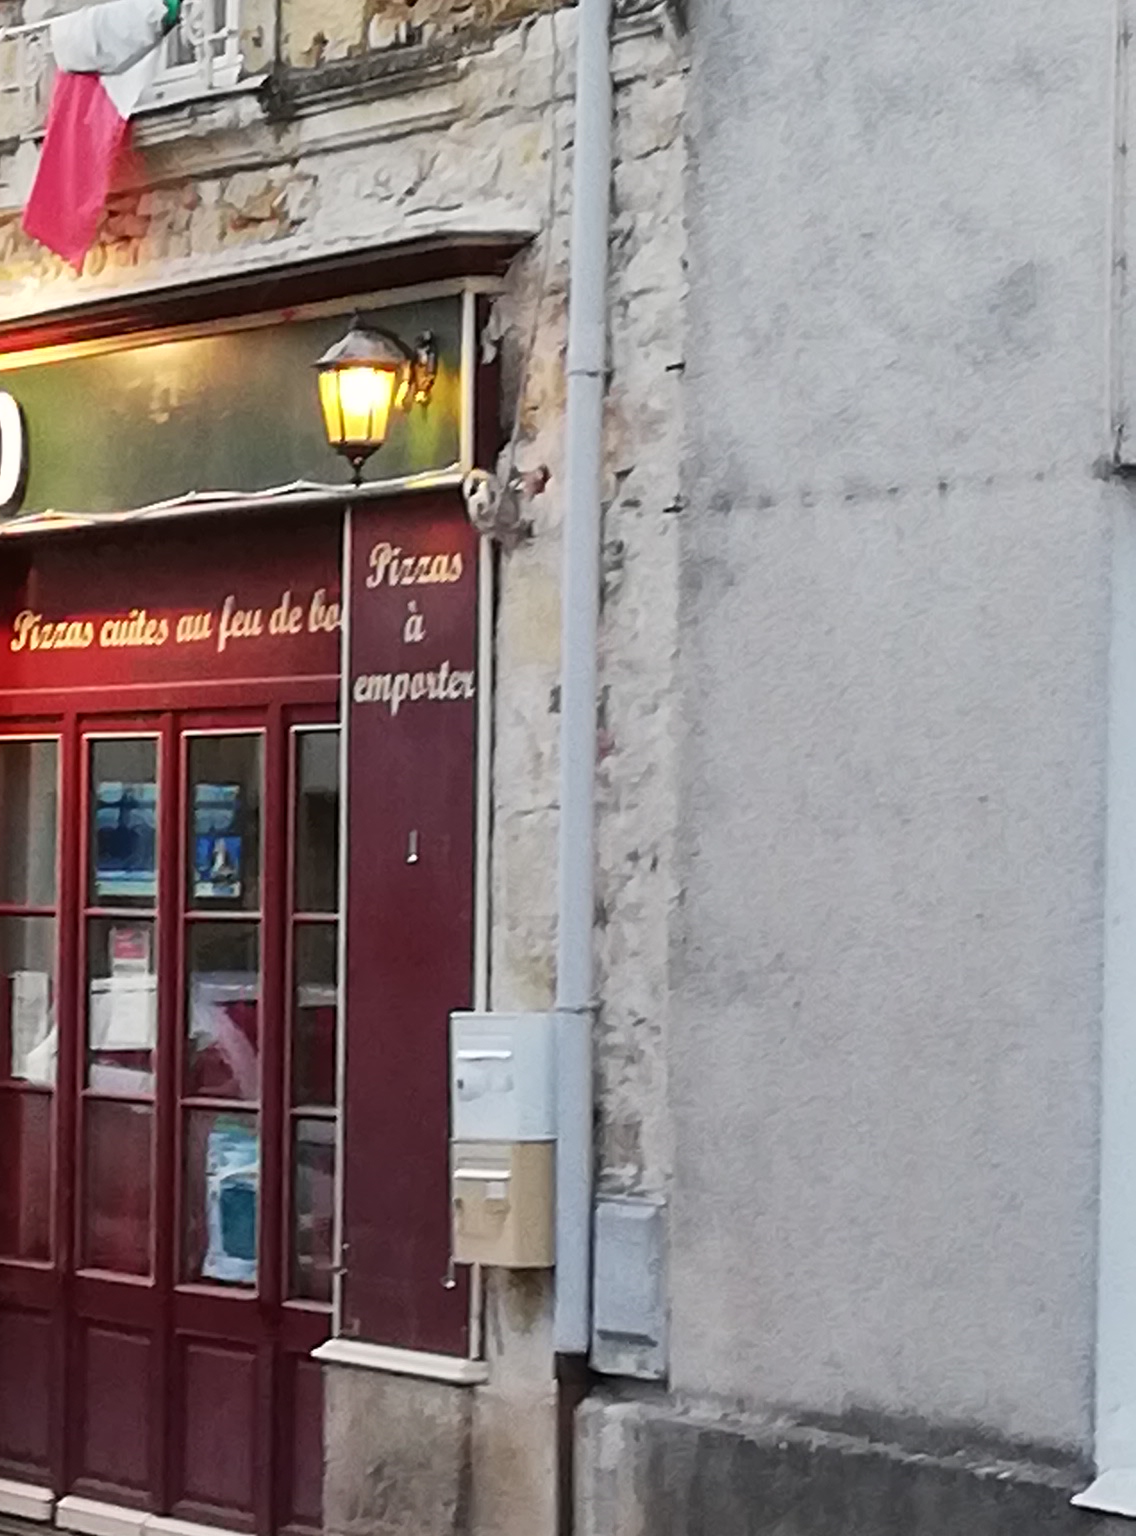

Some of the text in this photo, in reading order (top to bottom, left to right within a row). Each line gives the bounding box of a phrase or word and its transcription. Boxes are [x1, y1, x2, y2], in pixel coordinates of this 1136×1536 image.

[366, 542, 463, 589] Pizzas
[10, 609, 95, 652] Pizzas
[176, 611, 213, 644] au
[217, 594, 263, 653] feu
[268, 590, 303, 636] de
[403, 600, 426, 643] à
[353, 660, 476, 717] emporter
